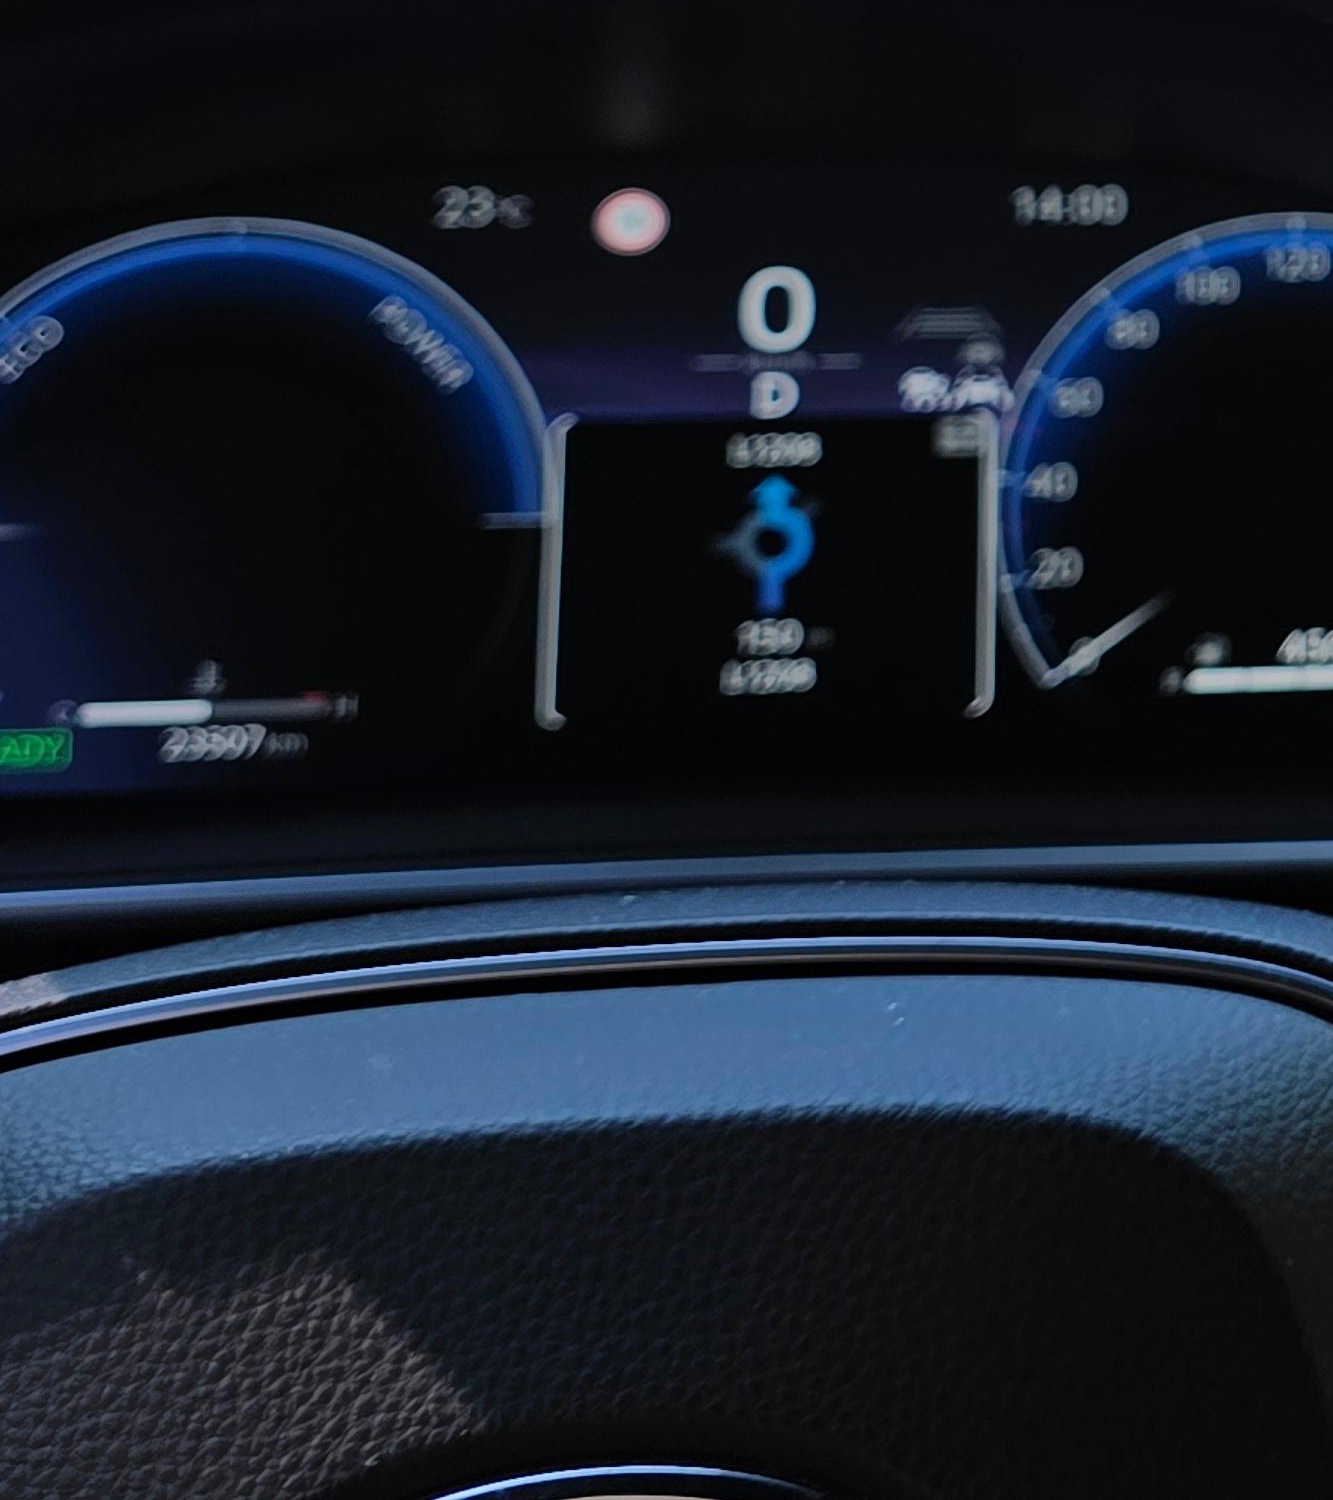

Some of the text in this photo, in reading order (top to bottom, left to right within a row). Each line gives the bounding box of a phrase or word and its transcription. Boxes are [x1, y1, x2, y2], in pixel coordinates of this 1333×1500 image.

[431, 185, 496, 229] 23
[1010, 183, 1128, 226] 14:00
[1265, 241, 1331, 283] 120
[1175, 265, 1241, 306] 100
[737, 265, 816, 353] 0
[750, 371, 800, 419] D
[1024, 461, 1079, 502] 40
[1028, 546, 1084, 590] 20
